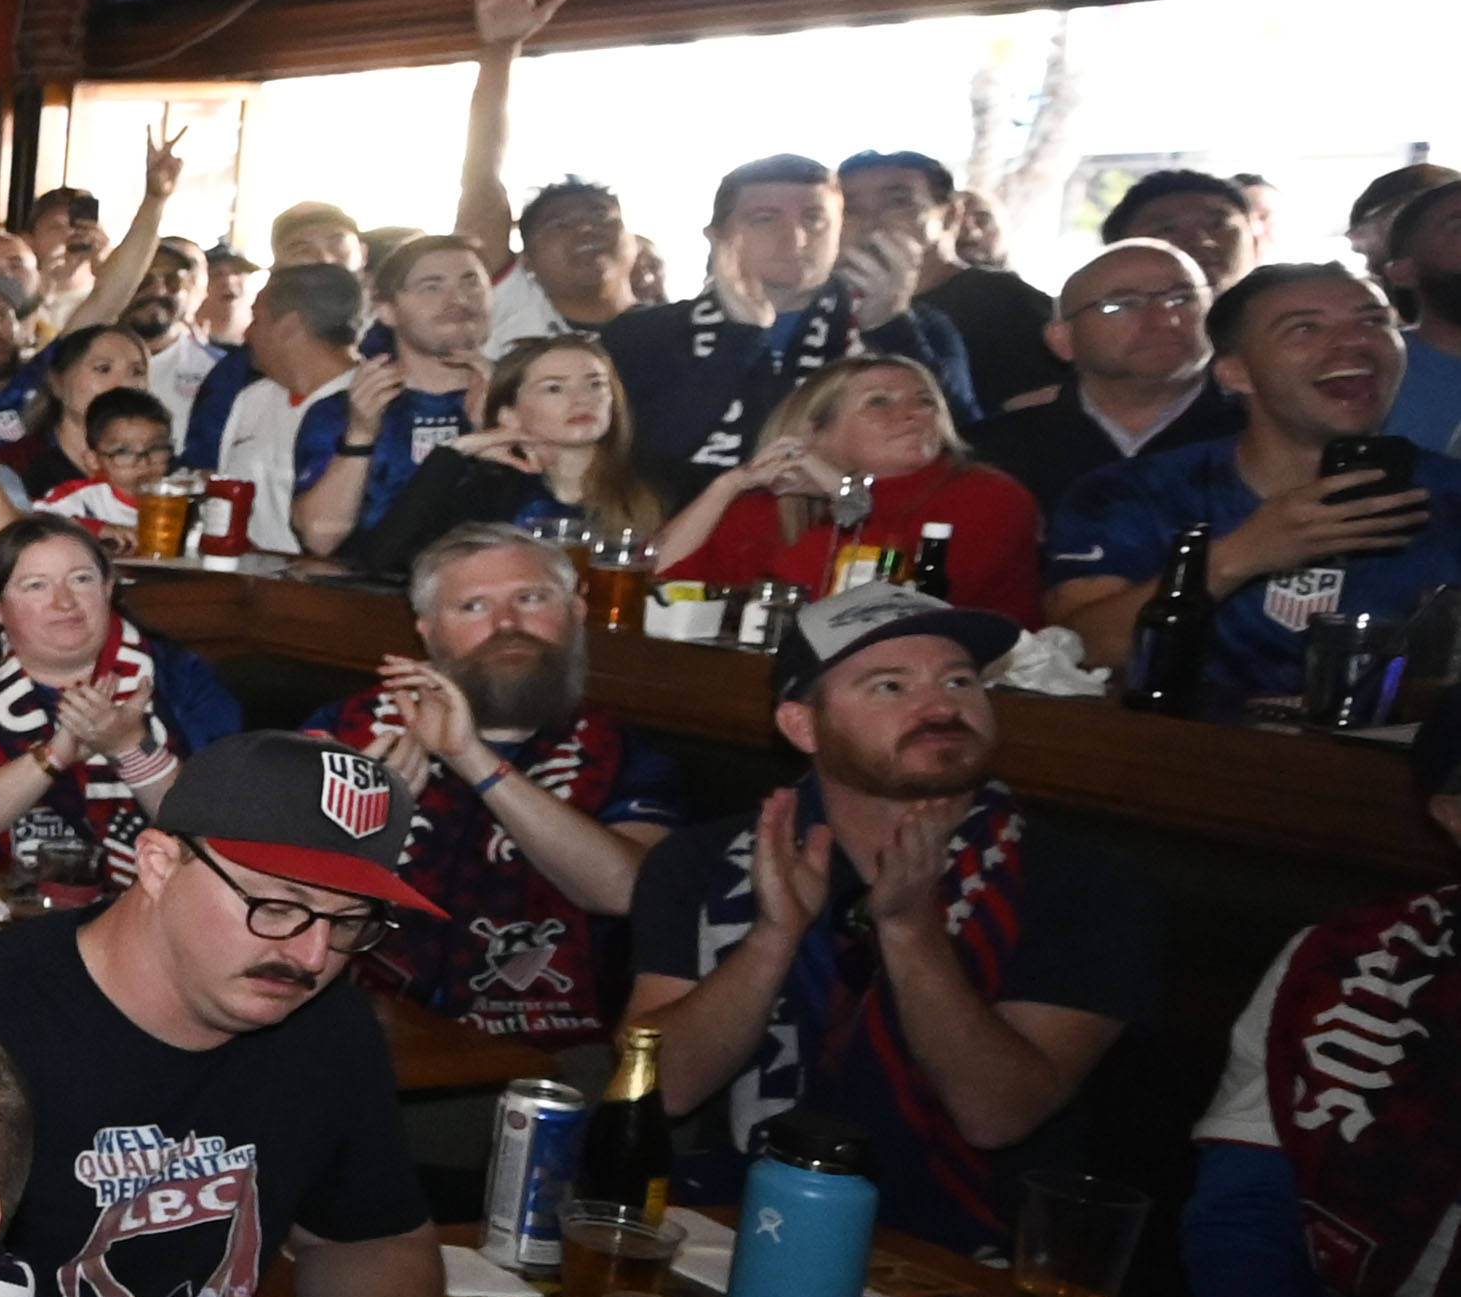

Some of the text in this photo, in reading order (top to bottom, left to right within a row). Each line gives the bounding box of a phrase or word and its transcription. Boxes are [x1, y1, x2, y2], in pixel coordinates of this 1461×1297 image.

[327, 753, 387, 791] USA
[98, 1128, 176, 1155] WELL
[201, 1137, 225, 1155] TO
[119, 1174, 238, 1232] LBC
